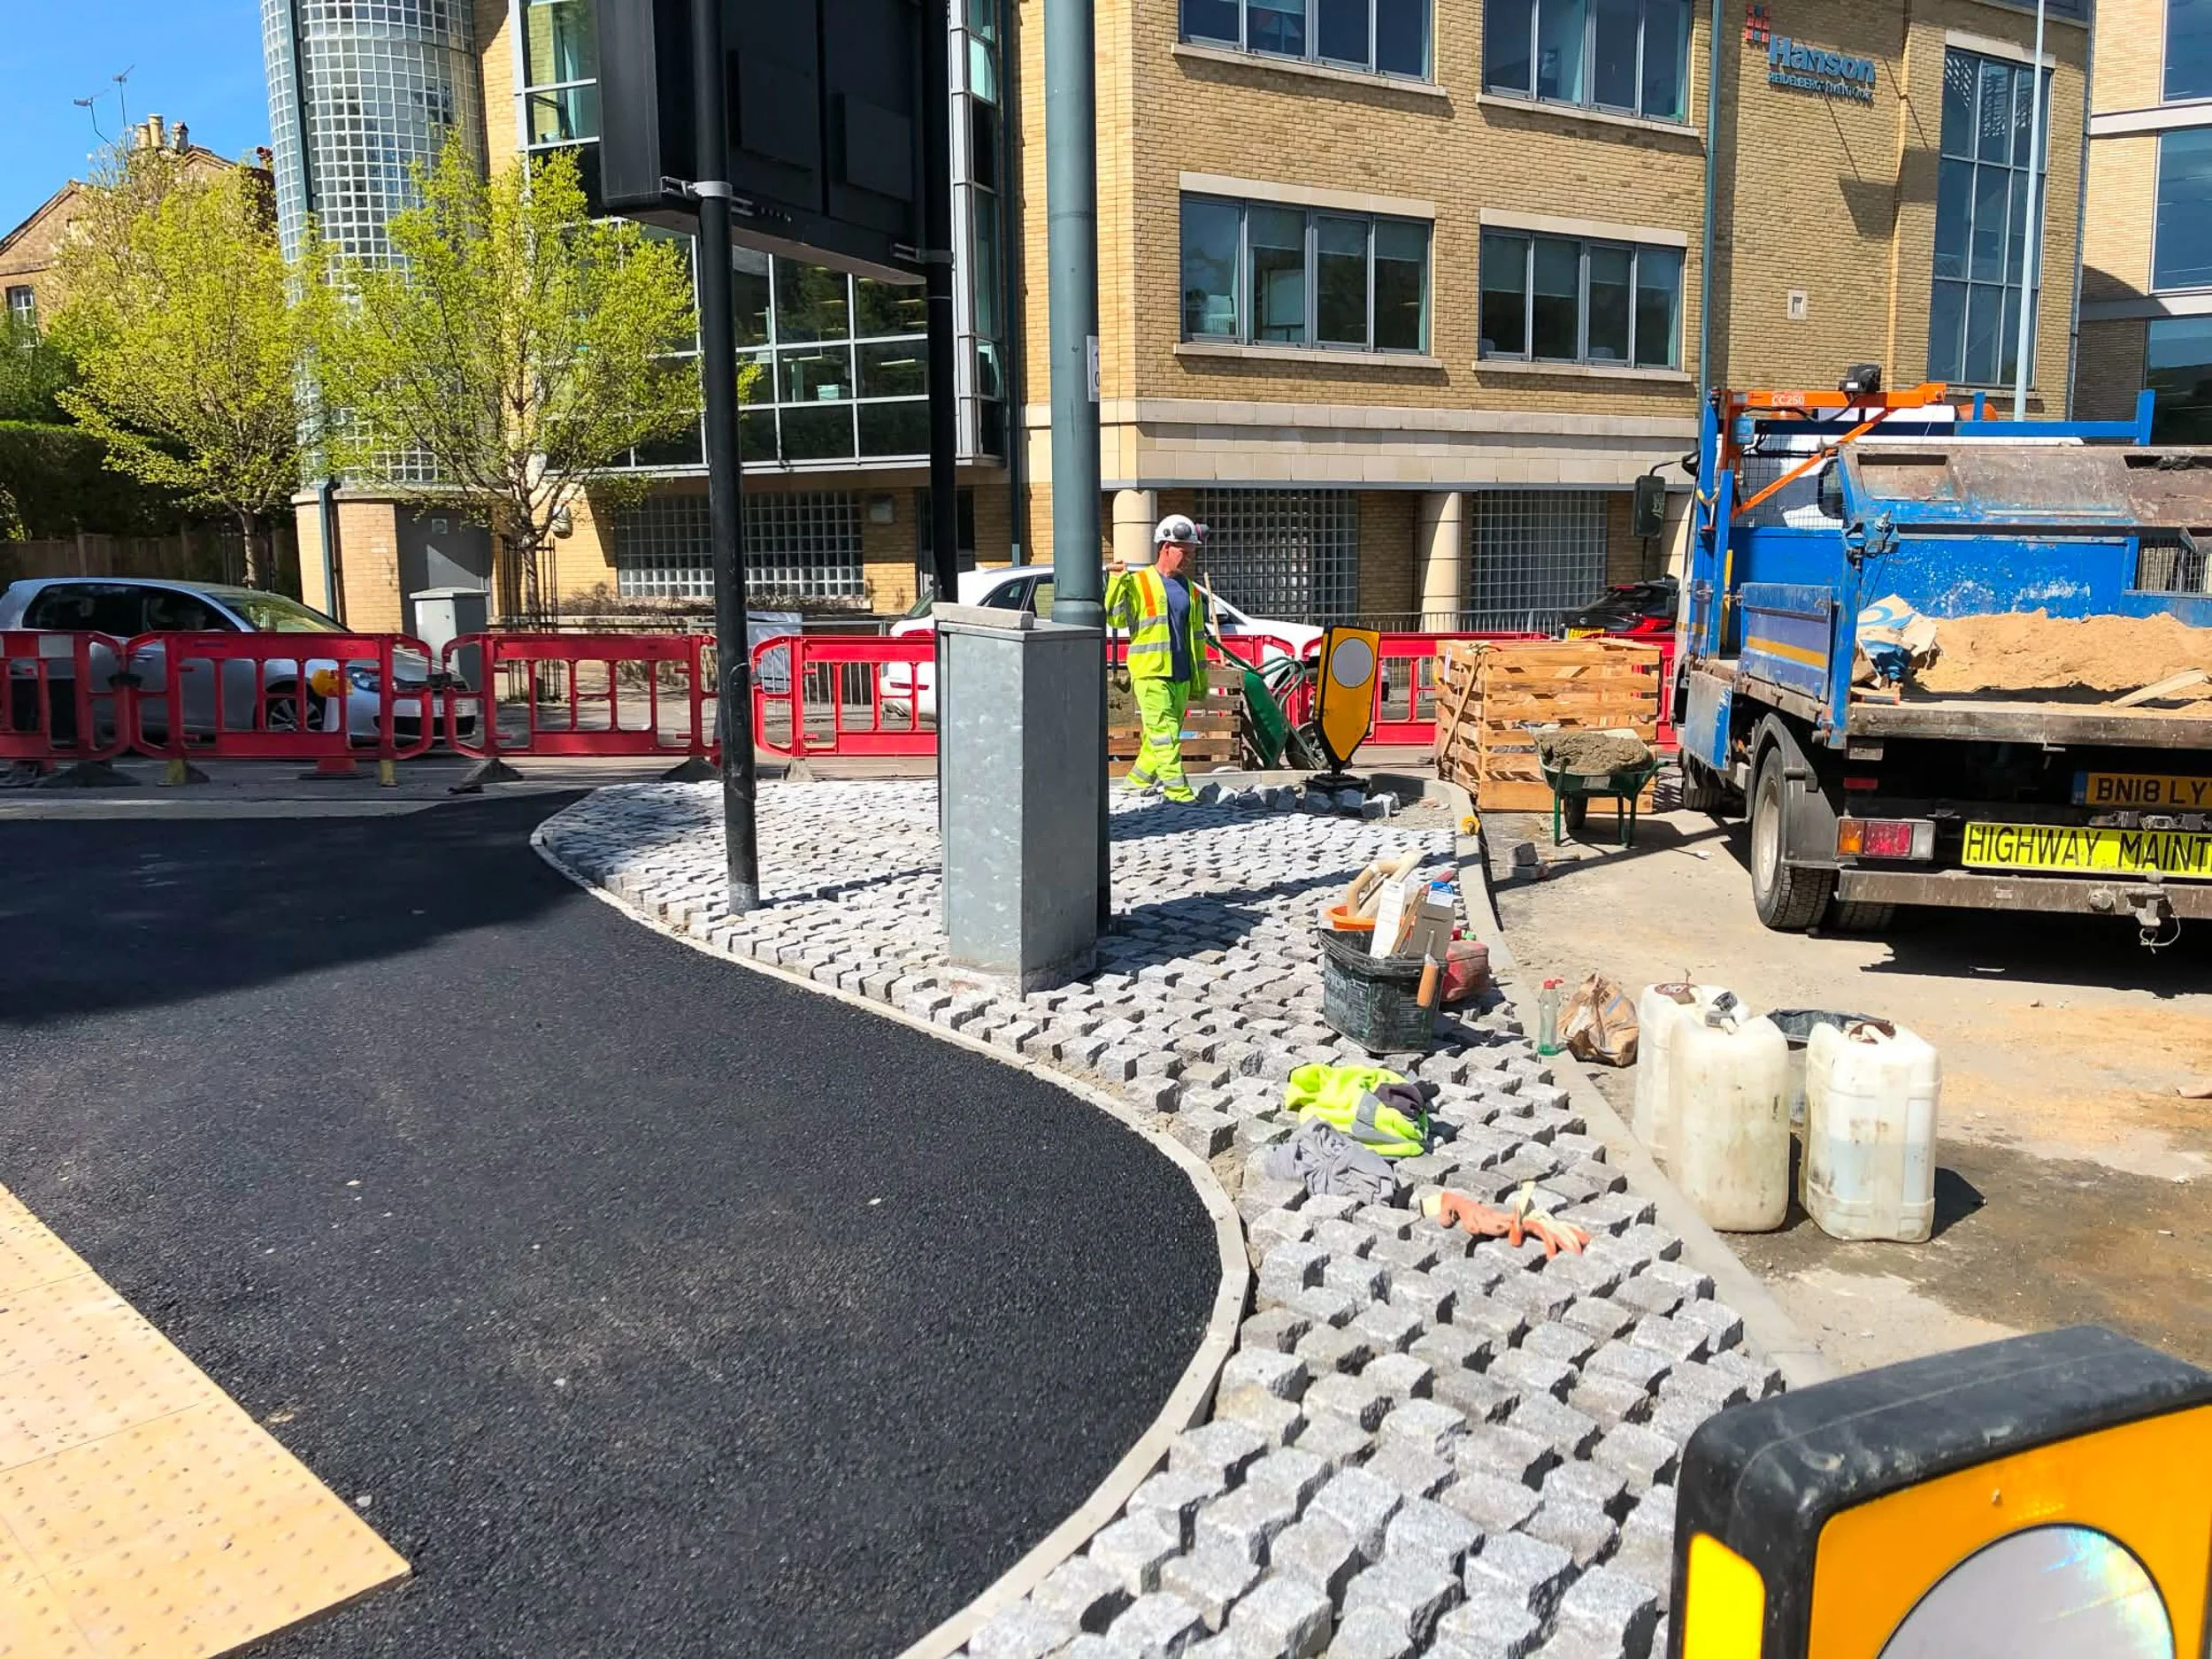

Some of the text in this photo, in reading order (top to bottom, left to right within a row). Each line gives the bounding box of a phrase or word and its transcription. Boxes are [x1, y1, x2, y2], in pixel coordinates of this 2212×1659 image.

[1769, 34, 1876, 83] Hanson
[2096, 777, 2212, 804] BN18 LY
[1967, 826, 2212, 872] HIGHWAY MAINT
